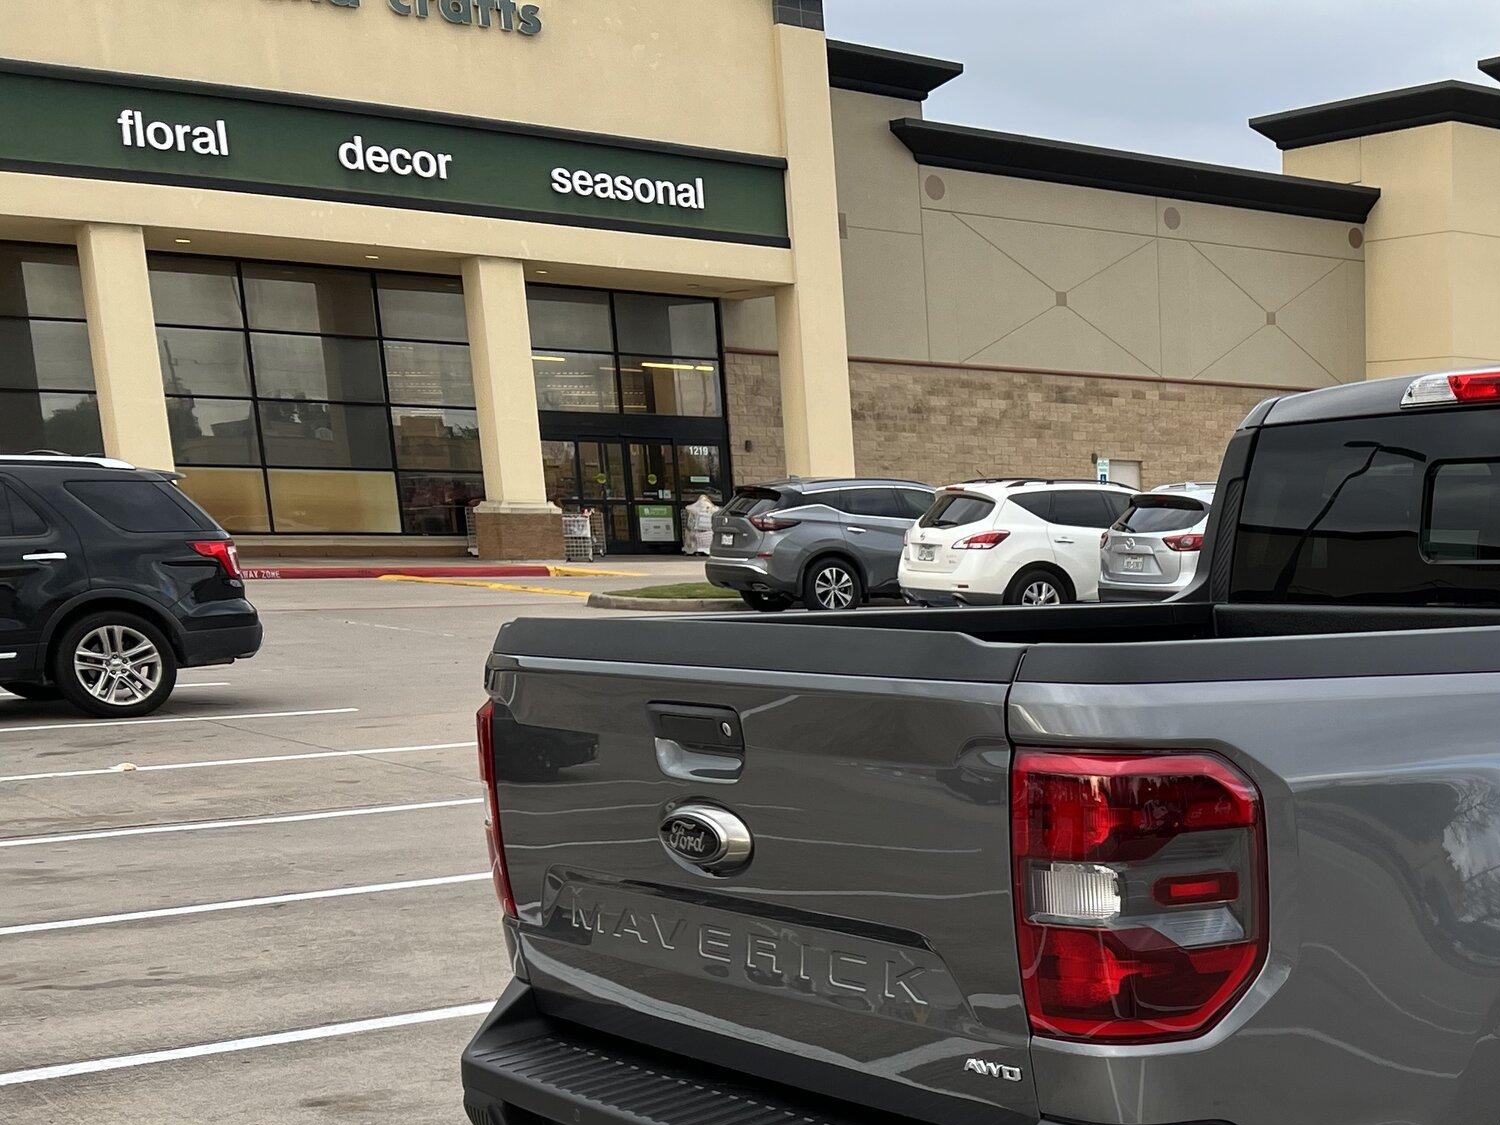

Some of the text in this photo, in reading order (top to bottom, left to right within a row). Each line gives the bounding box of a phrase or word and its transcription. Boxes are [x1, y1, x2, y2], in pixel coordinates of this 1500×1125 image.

[117, 109, 229, 157] floral
[338, 136, 452, 181] decor
[550, 163, 706, 210] seasonal
[689, 446, 708, 456] 1219
[261, 569, 280, 579] ZONE
[669, 819, 708, 853] Ford
[570, 897, 929, 1005] MAVERICK
[964, 1057, 1023, 1083] AWD
